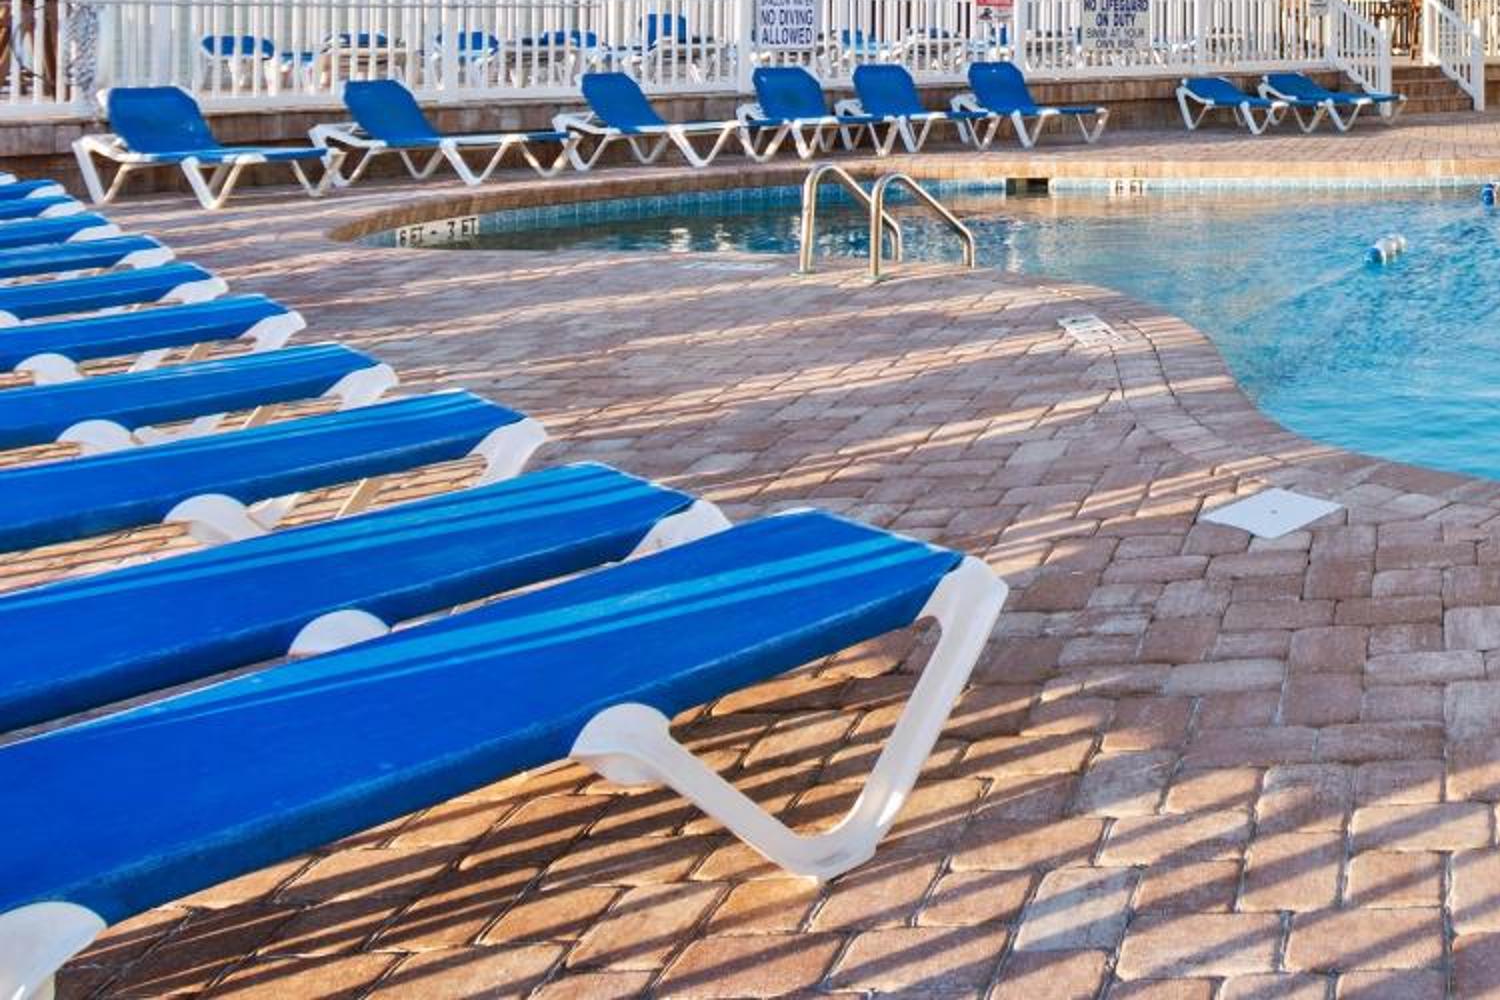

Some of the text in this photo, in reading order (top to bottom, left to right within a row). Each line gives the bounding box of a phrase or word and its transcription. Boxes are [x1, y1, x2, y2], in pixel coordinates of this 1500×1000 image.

[761, 8, 813, 25] NO DIVING
[1095, 11, 1136, 27] ON DUTY
[761, 27, 813, 45] ALLOWED
